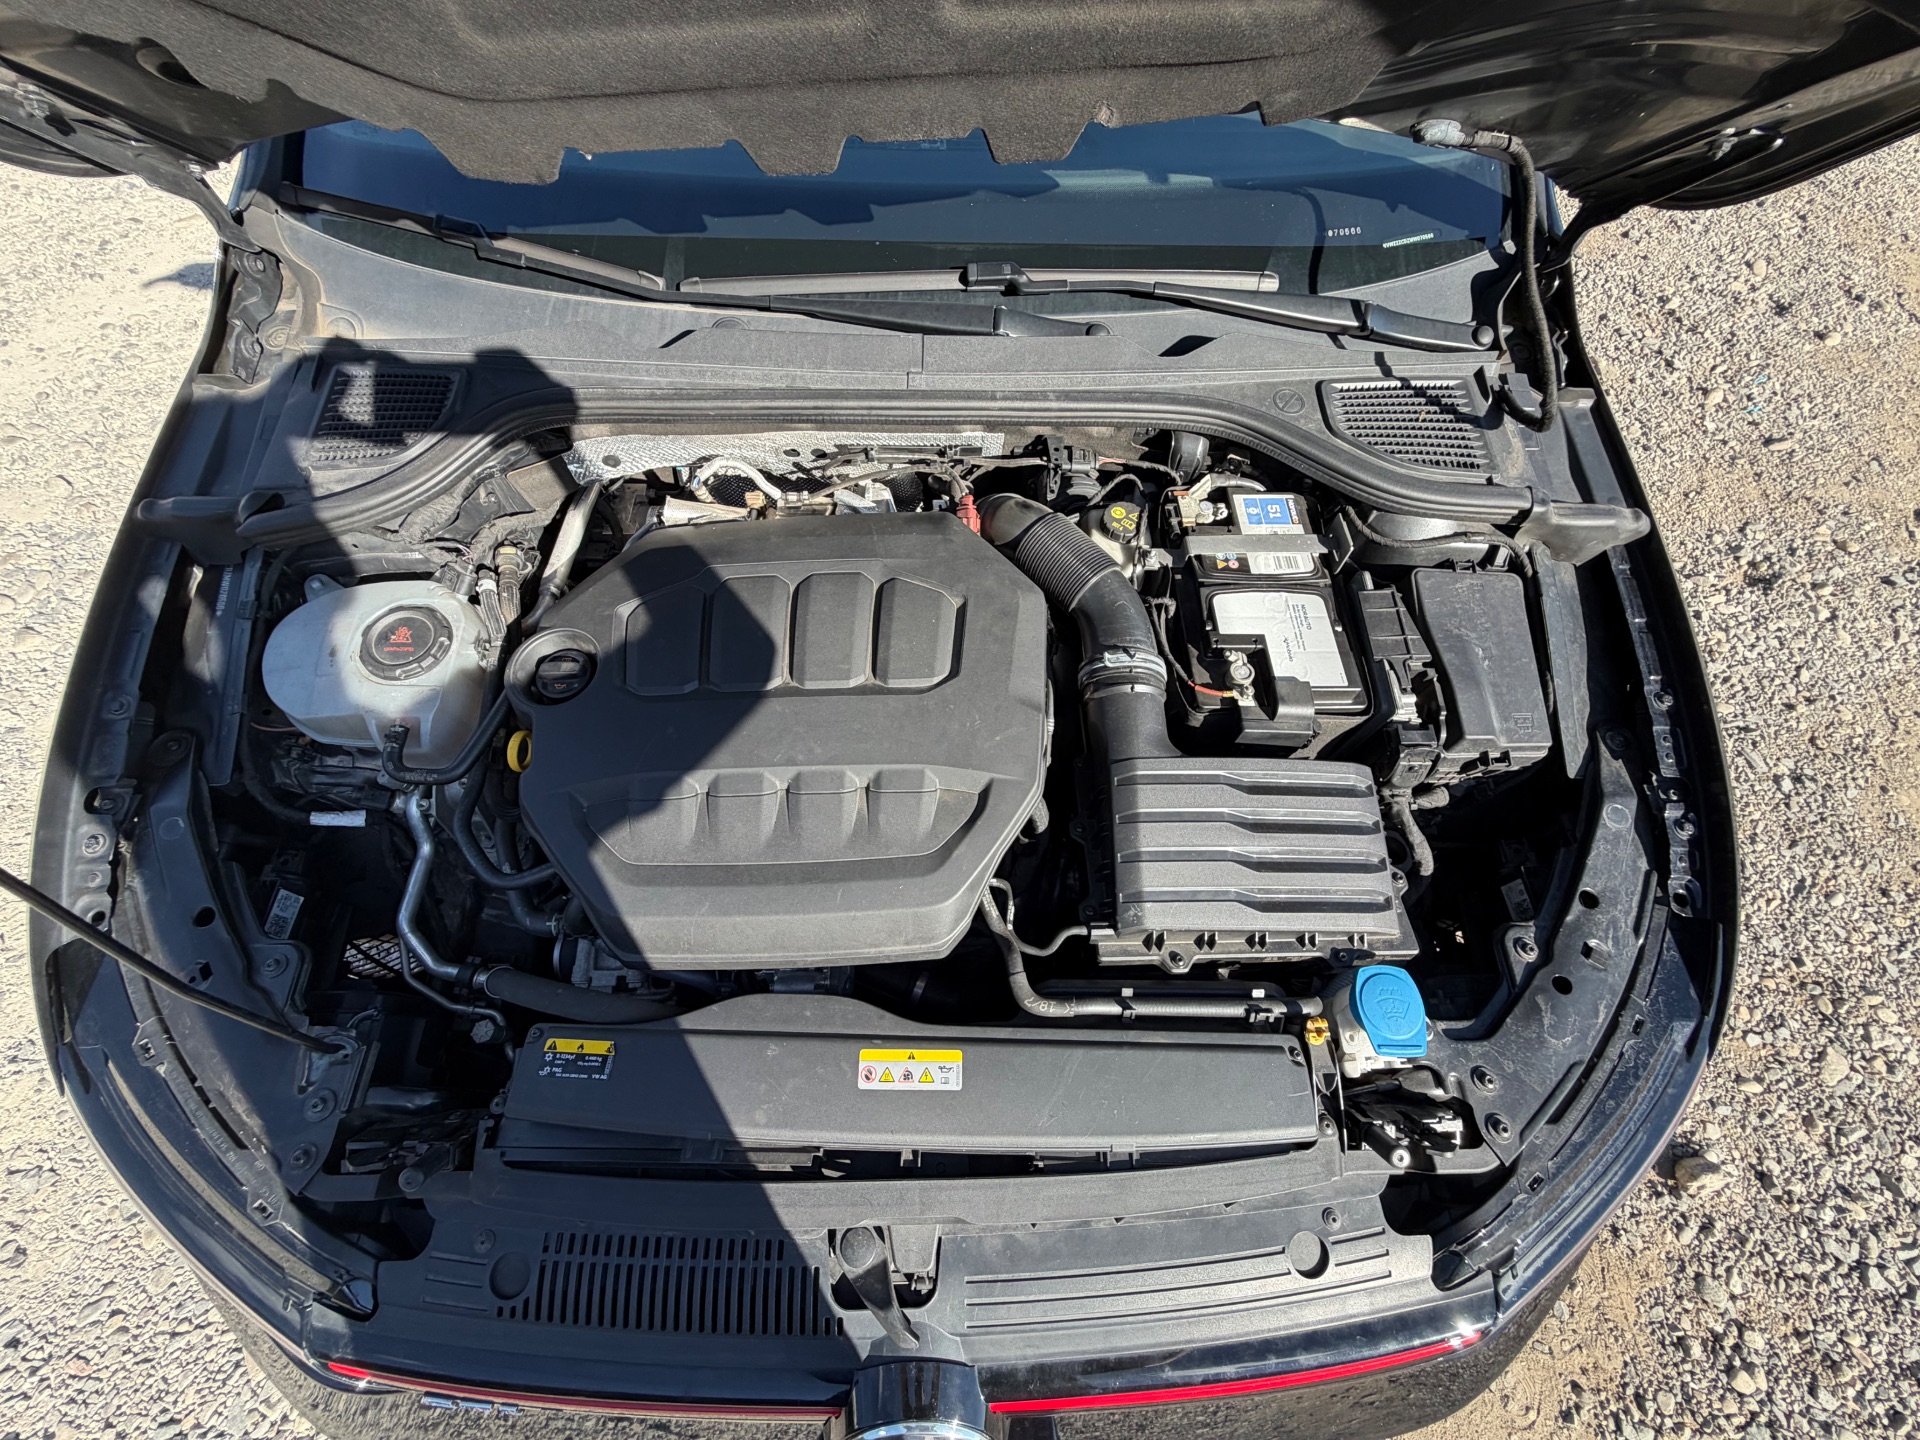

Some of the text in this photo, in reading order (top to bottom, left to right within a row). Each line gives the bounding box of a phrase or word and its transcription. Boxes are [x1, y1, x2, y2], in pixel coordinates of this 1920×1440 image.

[1266, 504, 1282, 519] 51
[1287, 499, 1299, 524] Norauto
[1301, 604, 1312, 630] NORAUTO
